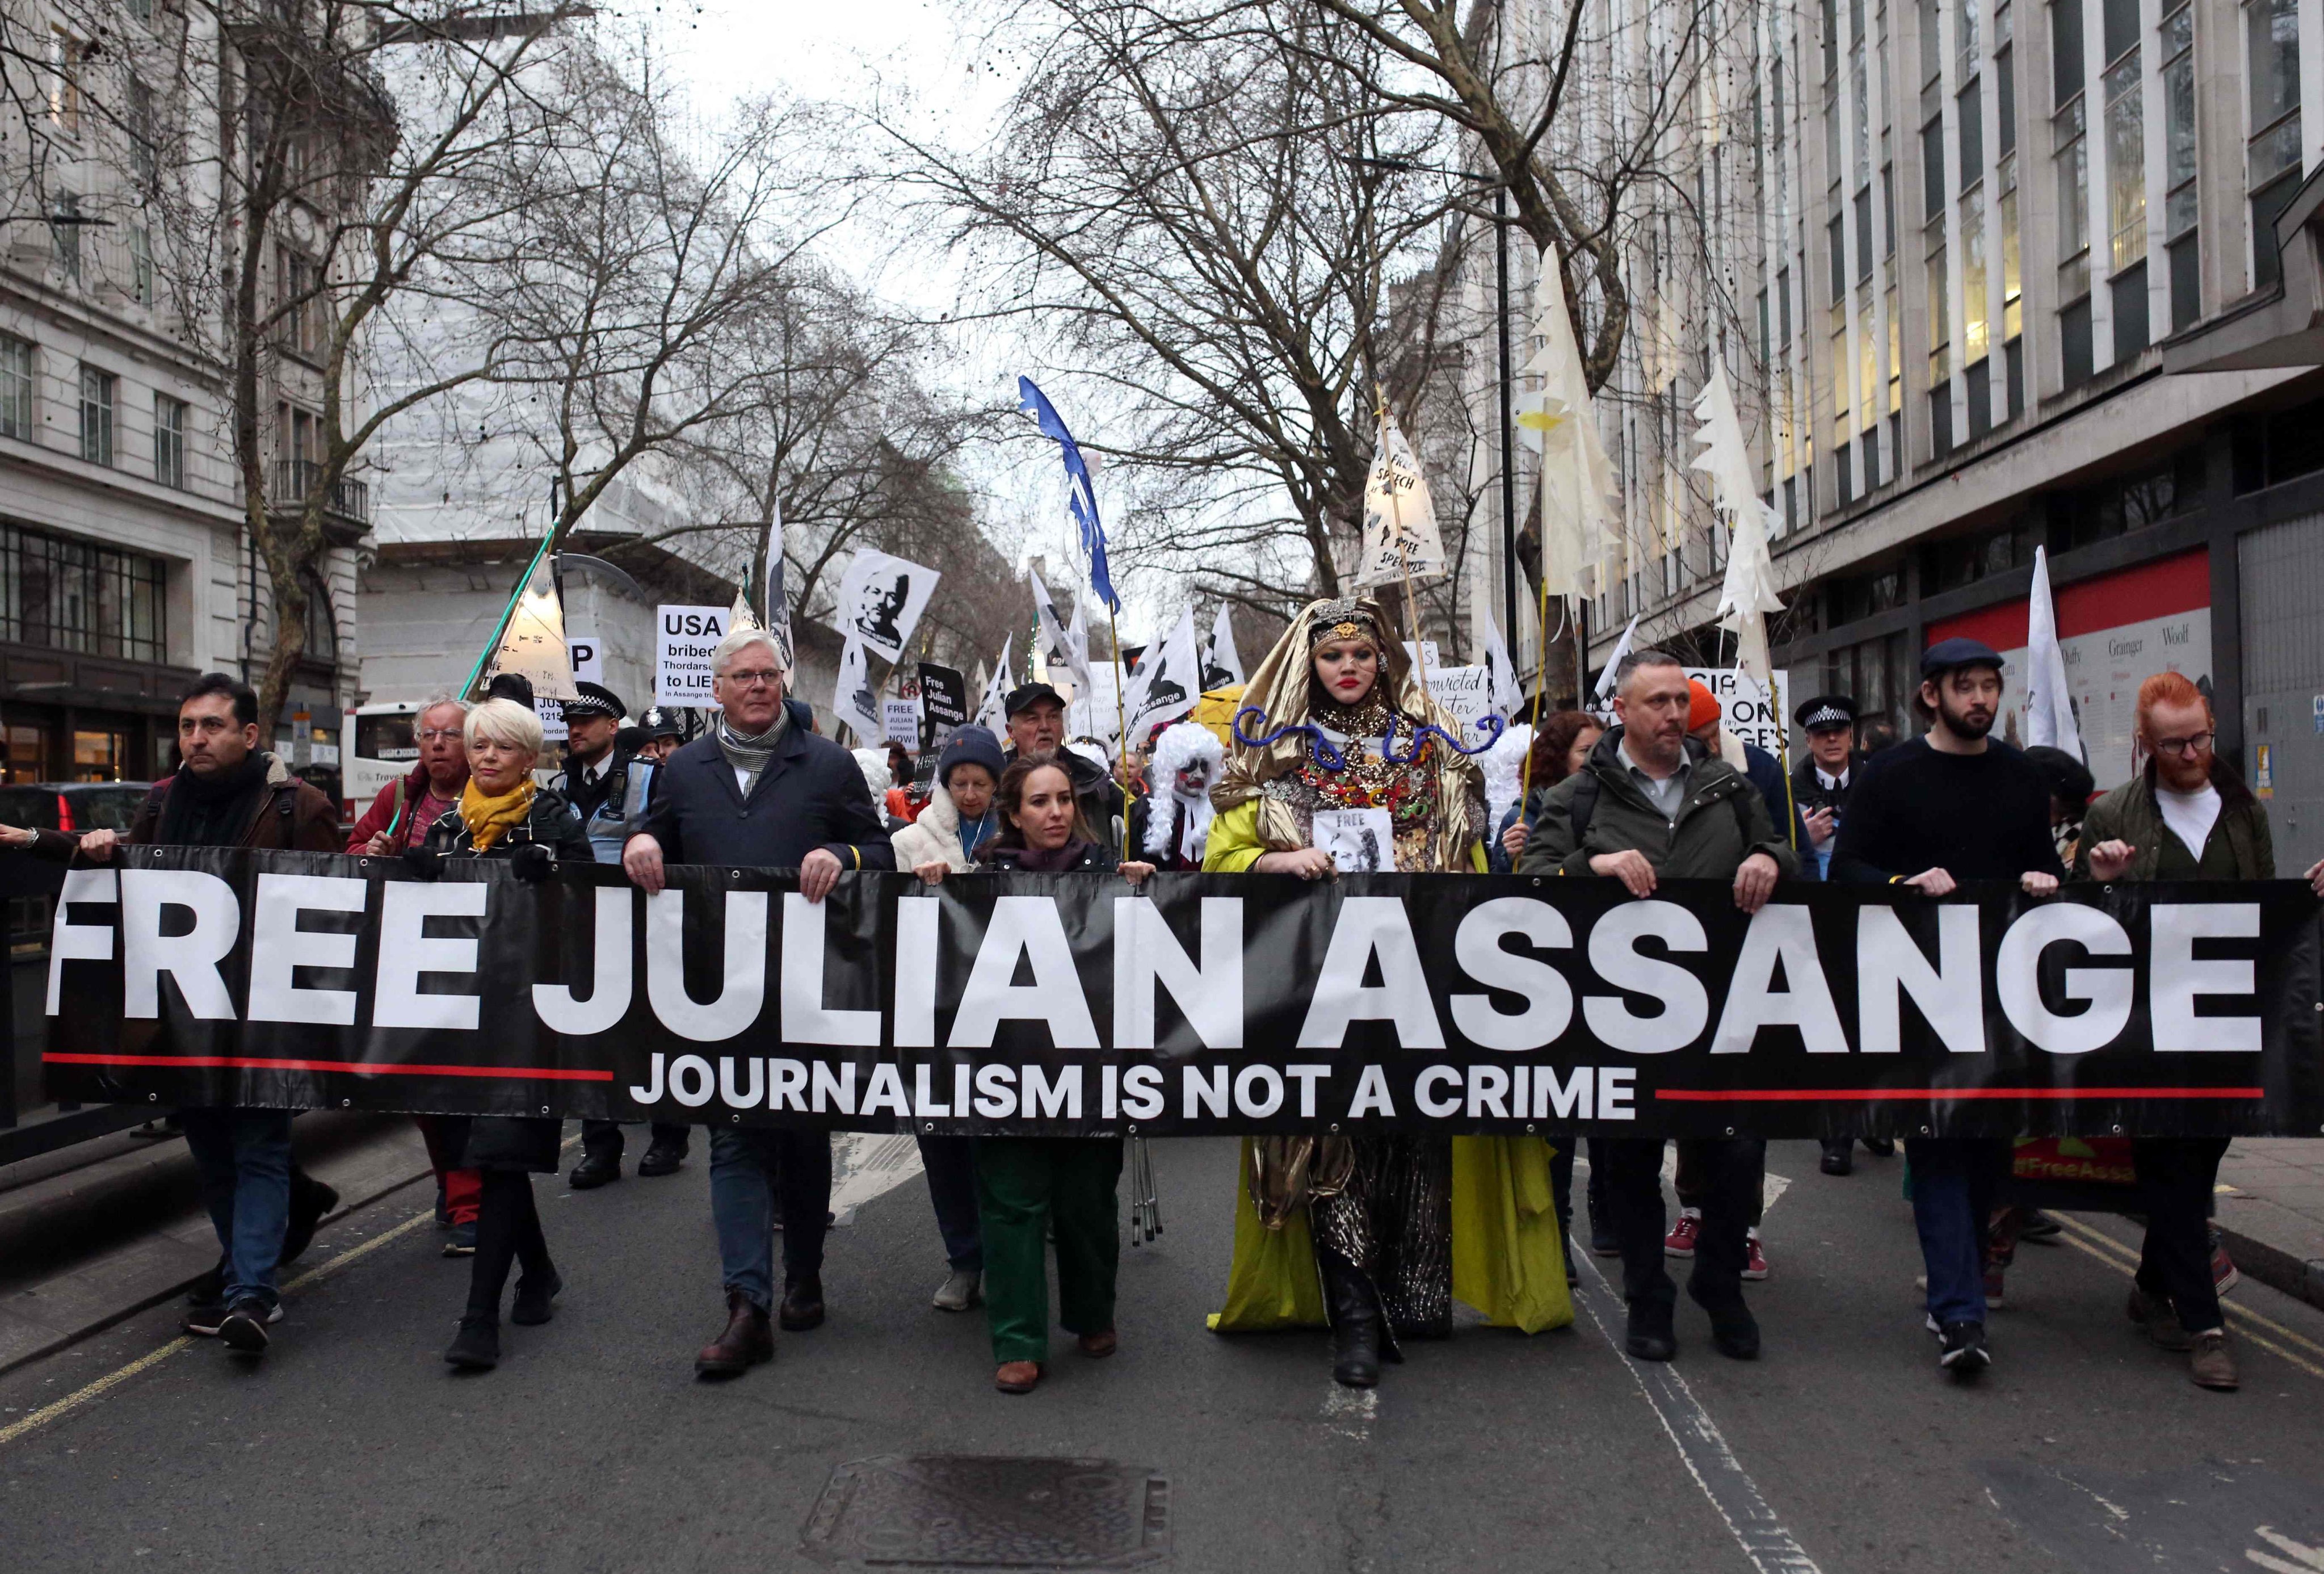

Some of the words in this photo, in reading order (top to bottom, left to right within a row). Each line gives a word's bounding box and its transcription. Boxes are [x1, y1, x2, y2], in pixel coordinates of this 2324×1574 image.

[666, 615, 722, 636] USA
[2162, 624, 2189, 646] Woolf
[669, 644, 716, 657] bribed
[2109, 637, 2144, 657] Grainger
[663, 661, 713, 670] Thordars
[667, 675, 681, 687] to
[687, 675, 711, 687] LIE
[925, 675, 944, 690] Free
[927, 689, 952, 705] Julian
[888, 705, 914, 714] FREE
[929, 702, 964, 721] Assange
[889, 734, 915, 744] NOW!
[1337, 813, 1365, 827] FREE
[45, 868, 488, 1030] FREE
[531, 885, 1243, 1049] JULIAN
[1296, 896, 2263, 1055] ASSANGE
[630, 1052, 1082, 1119] JOURNALISM
[1102, 1065, 1165, 1119] IS
[1183, 1064, 1332, 1119] NOT
[1347, 1065, 1396, 1118] A
[1414, 1065, 1636, 1121] CRIME
[2012, 1157, 2136, 1182] #FreeAssa
